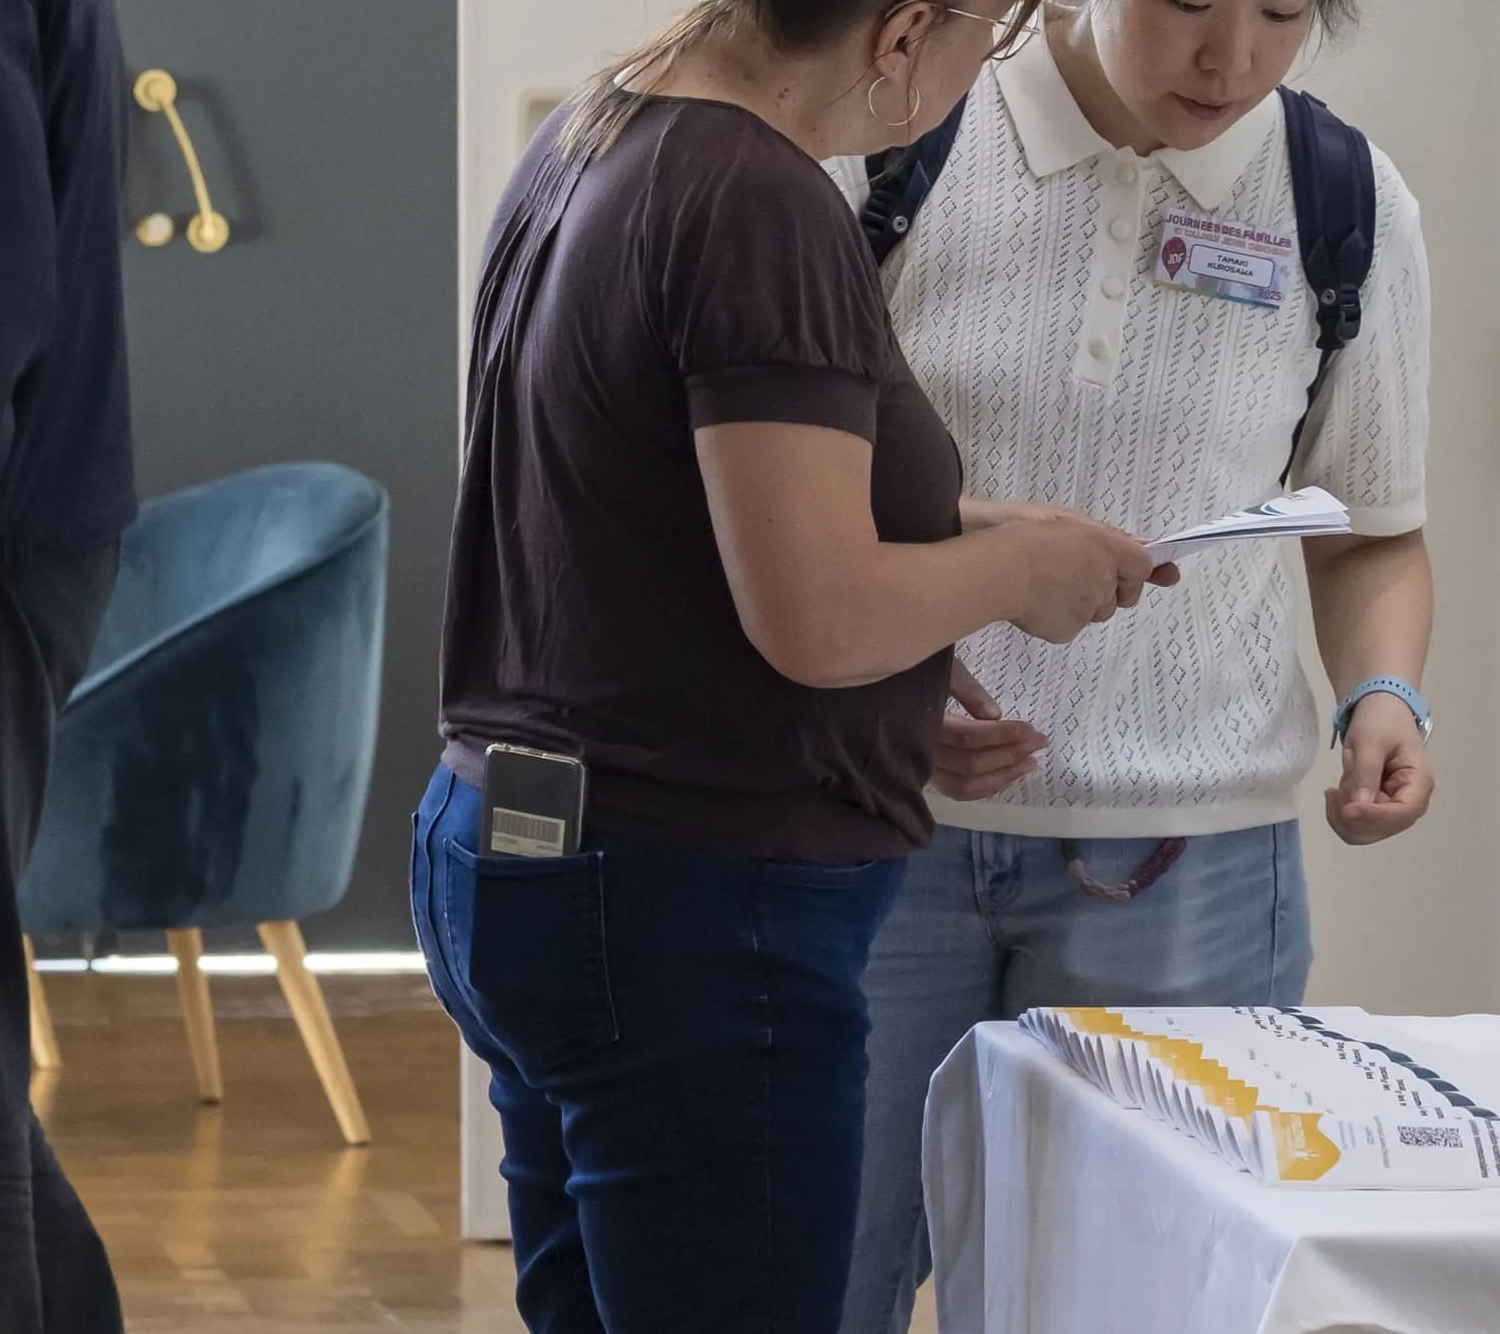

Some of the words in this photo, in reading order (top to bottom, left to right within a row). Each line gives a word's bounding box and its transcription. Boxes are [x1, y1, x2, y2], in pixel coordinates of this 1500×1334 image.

[1222, 227, 1243, 238] DES
[1167, 252, 1185, 265] JDF
[1217, 254, 1249, 267] TAMAKI
[1257, 288, 1282, 302] 2025
